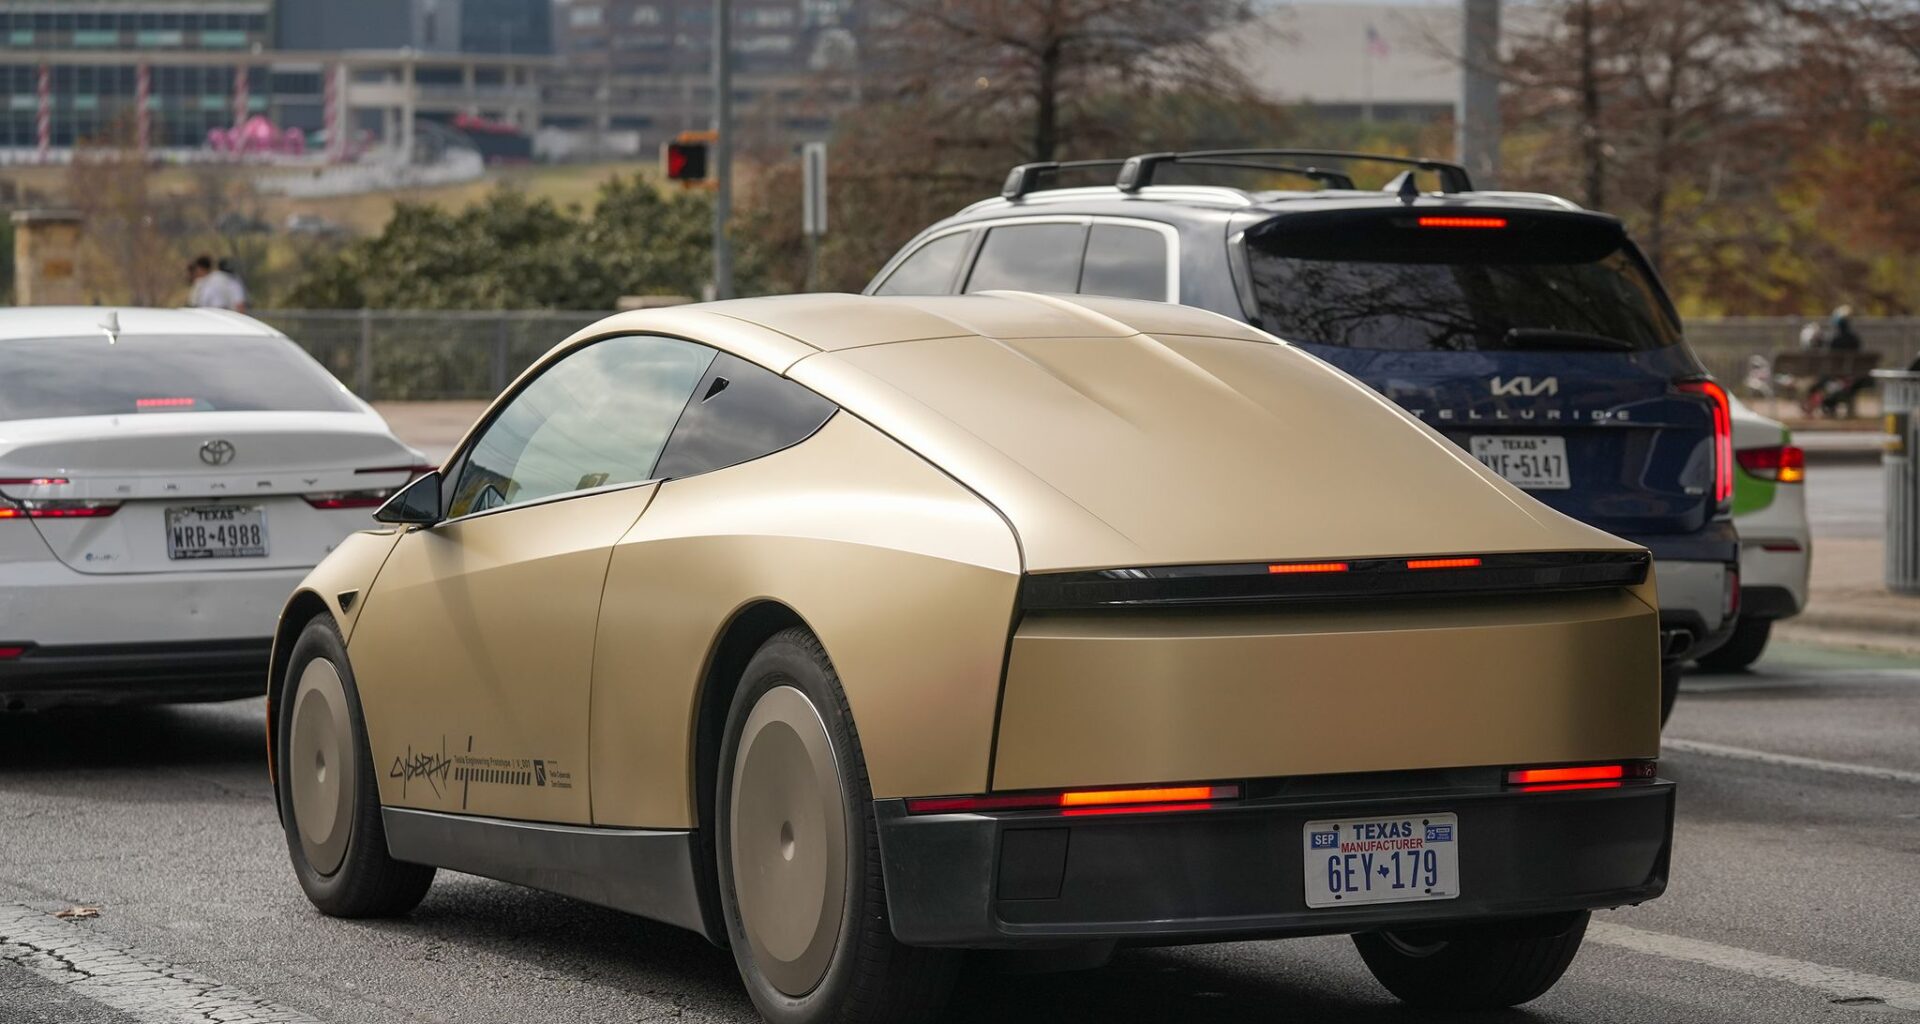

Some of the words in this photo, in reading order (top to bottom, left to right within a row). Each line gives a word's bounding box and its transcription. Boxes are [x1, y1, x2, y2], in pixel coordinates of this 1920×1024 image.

[1411, 409, 1630, 420] TELLURIDE
[1502, 439, 1537, 450] TEXAS
[1520, 454, 1562, 478] 5147
[197, 510, 235, 521] TEXAS
[173, 526, 207, 548] WRB
[217, 524, 261, 547] 4988
[1353, 821, 1412, 840] TEXAS
[1427, 829, 1436, 840] 25
[1315, 834, 1334, 846] SEP
[1341, 838, 1423, 853] MANUFACTURER
[1328, 853, 1373, 893] 6EY
[1391, 849, 1437, 889] 179
